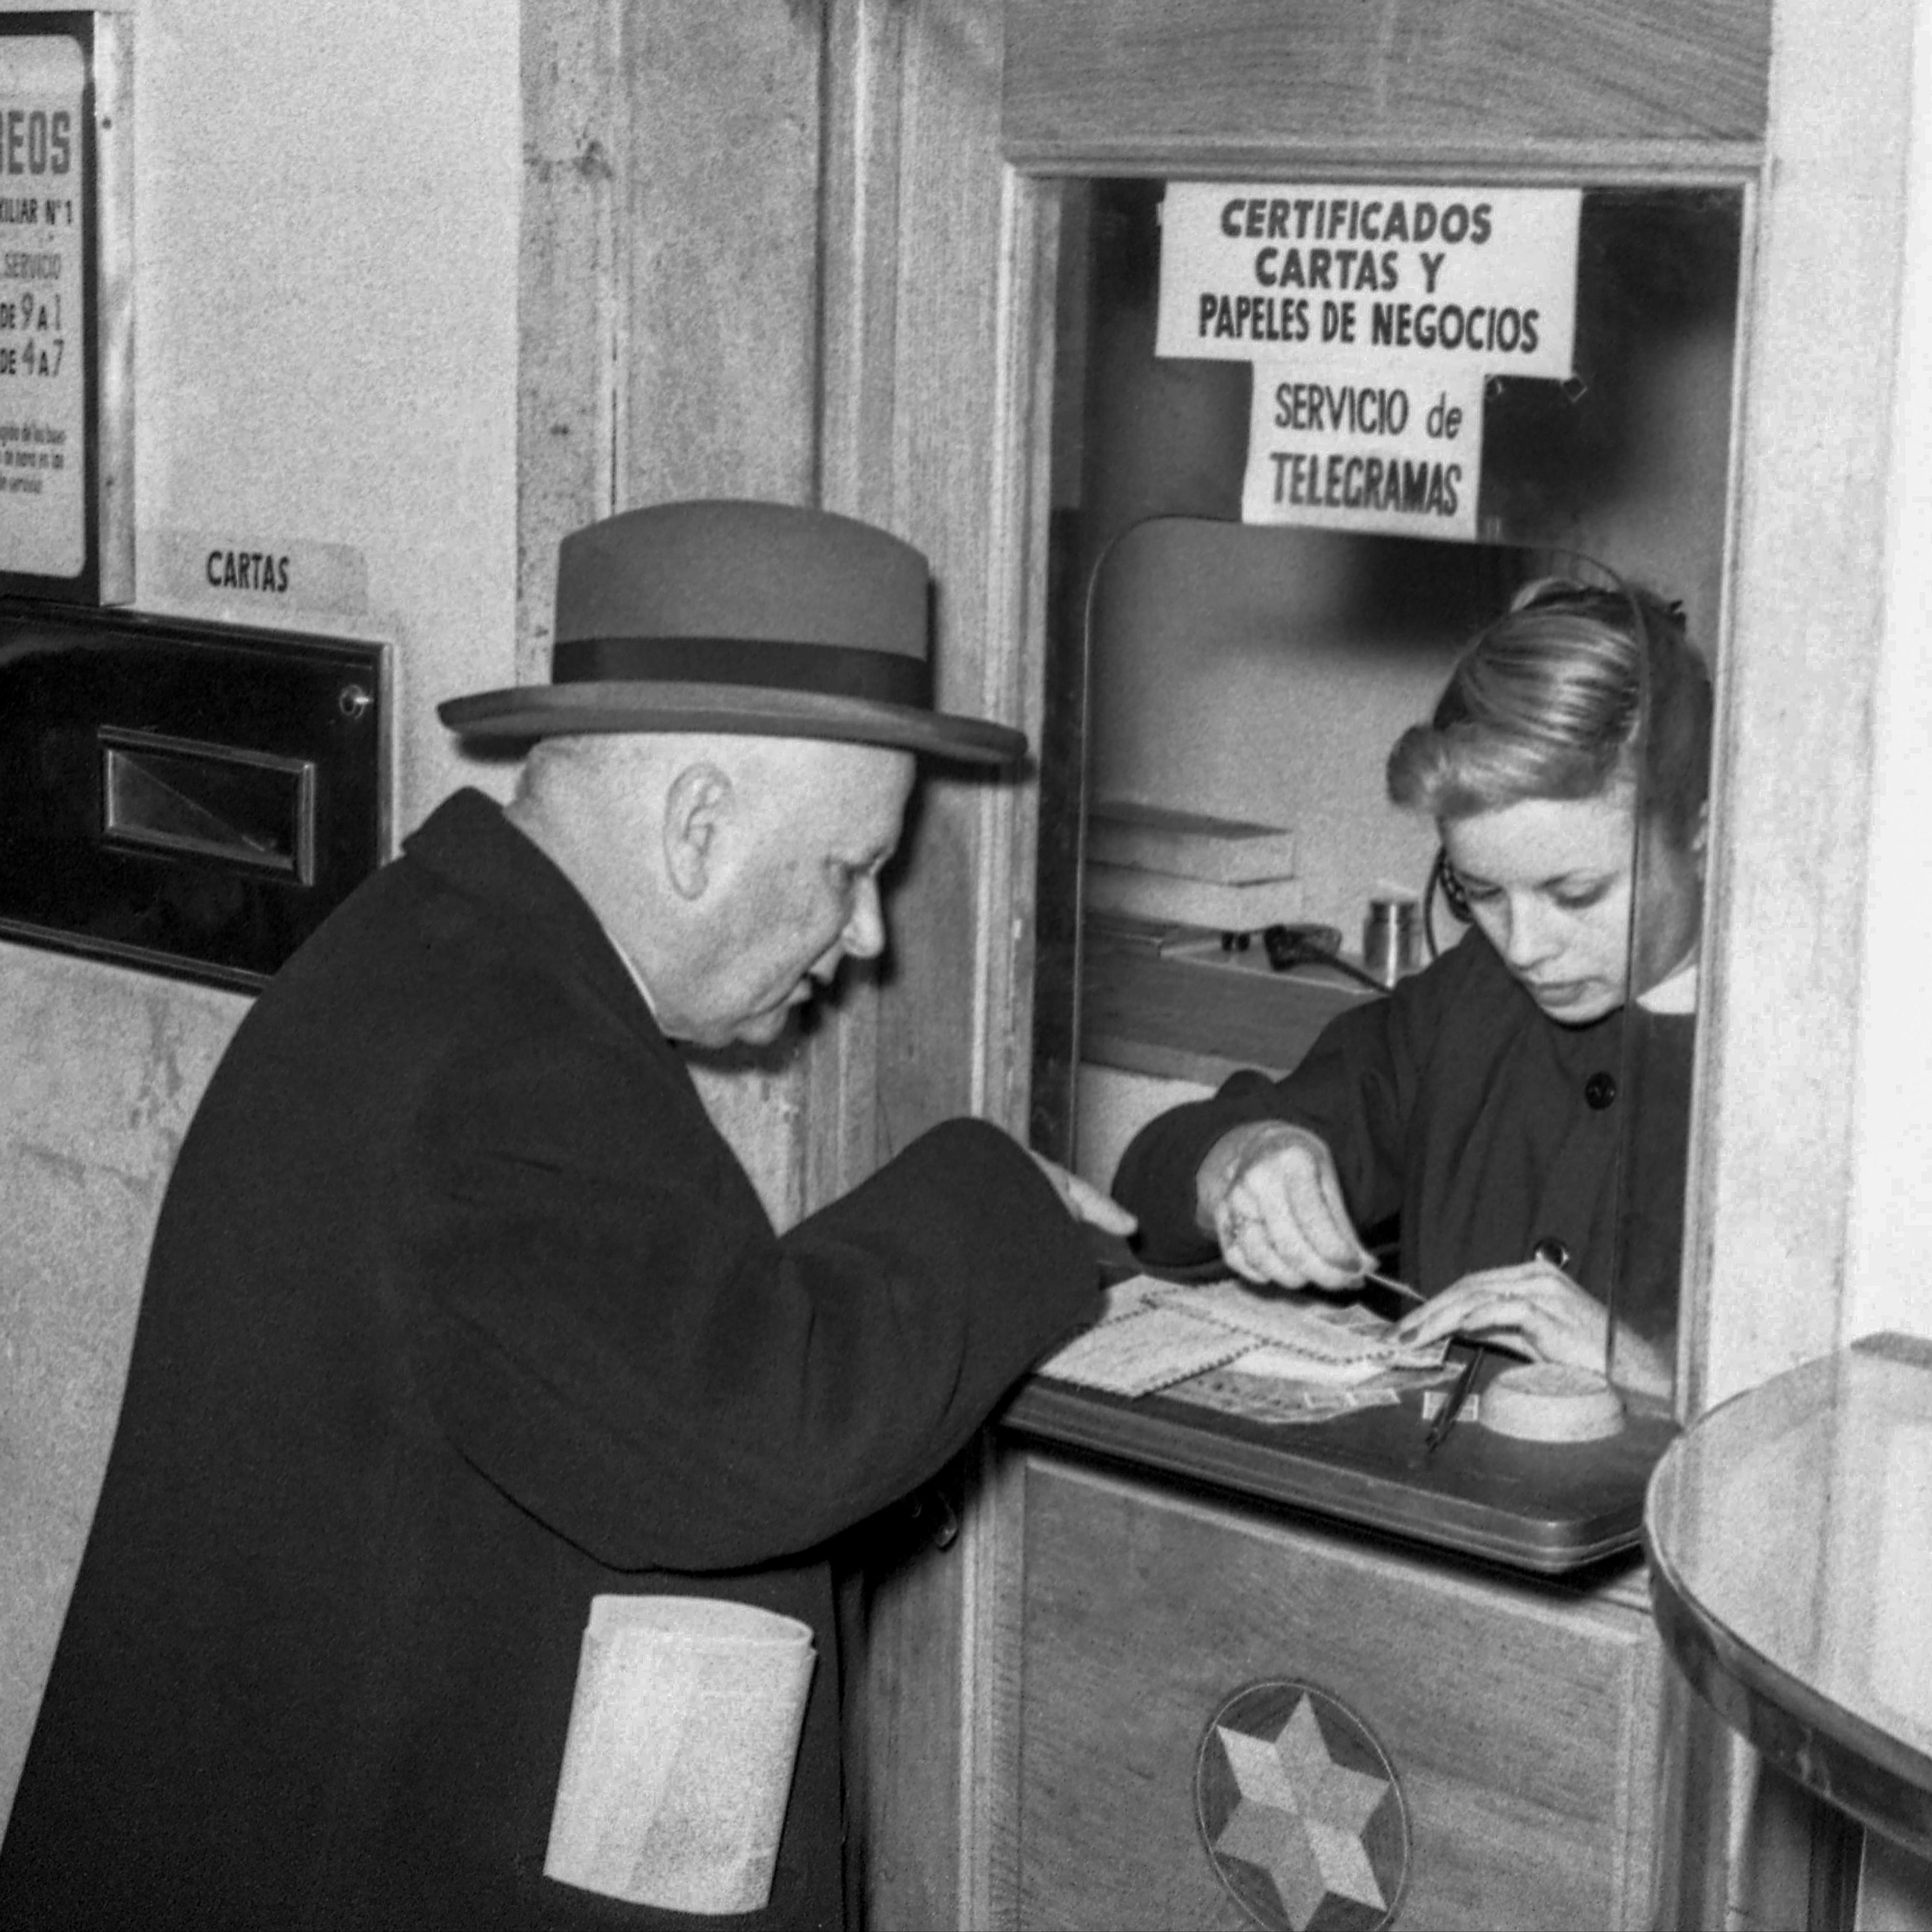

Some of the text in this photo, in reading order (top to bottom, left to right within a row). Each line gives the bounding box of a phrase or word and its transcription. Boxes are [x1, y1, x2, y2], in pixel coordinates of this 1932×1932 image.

[0, 111, 70, 174] EOS
[1221, 199, 1492, 244] CERTIFICADOS
[1255, 247, 1445, 293] CARTAS Y
[0, 303, 16, 330] DE
[22, 293, 34, 330] 9
[37, 305, 49, 331] A
[1199, 293, 1539, 354] PAPELES DE NEGOCIOS
[0, 338, 65, 378] DE 4 A 7
[1275, 383, 1463, 440] SERVICIO de
[1270, 452, 1462, 517] TELEGRAMAS
[206, 550, 290, 592] CARTAS
